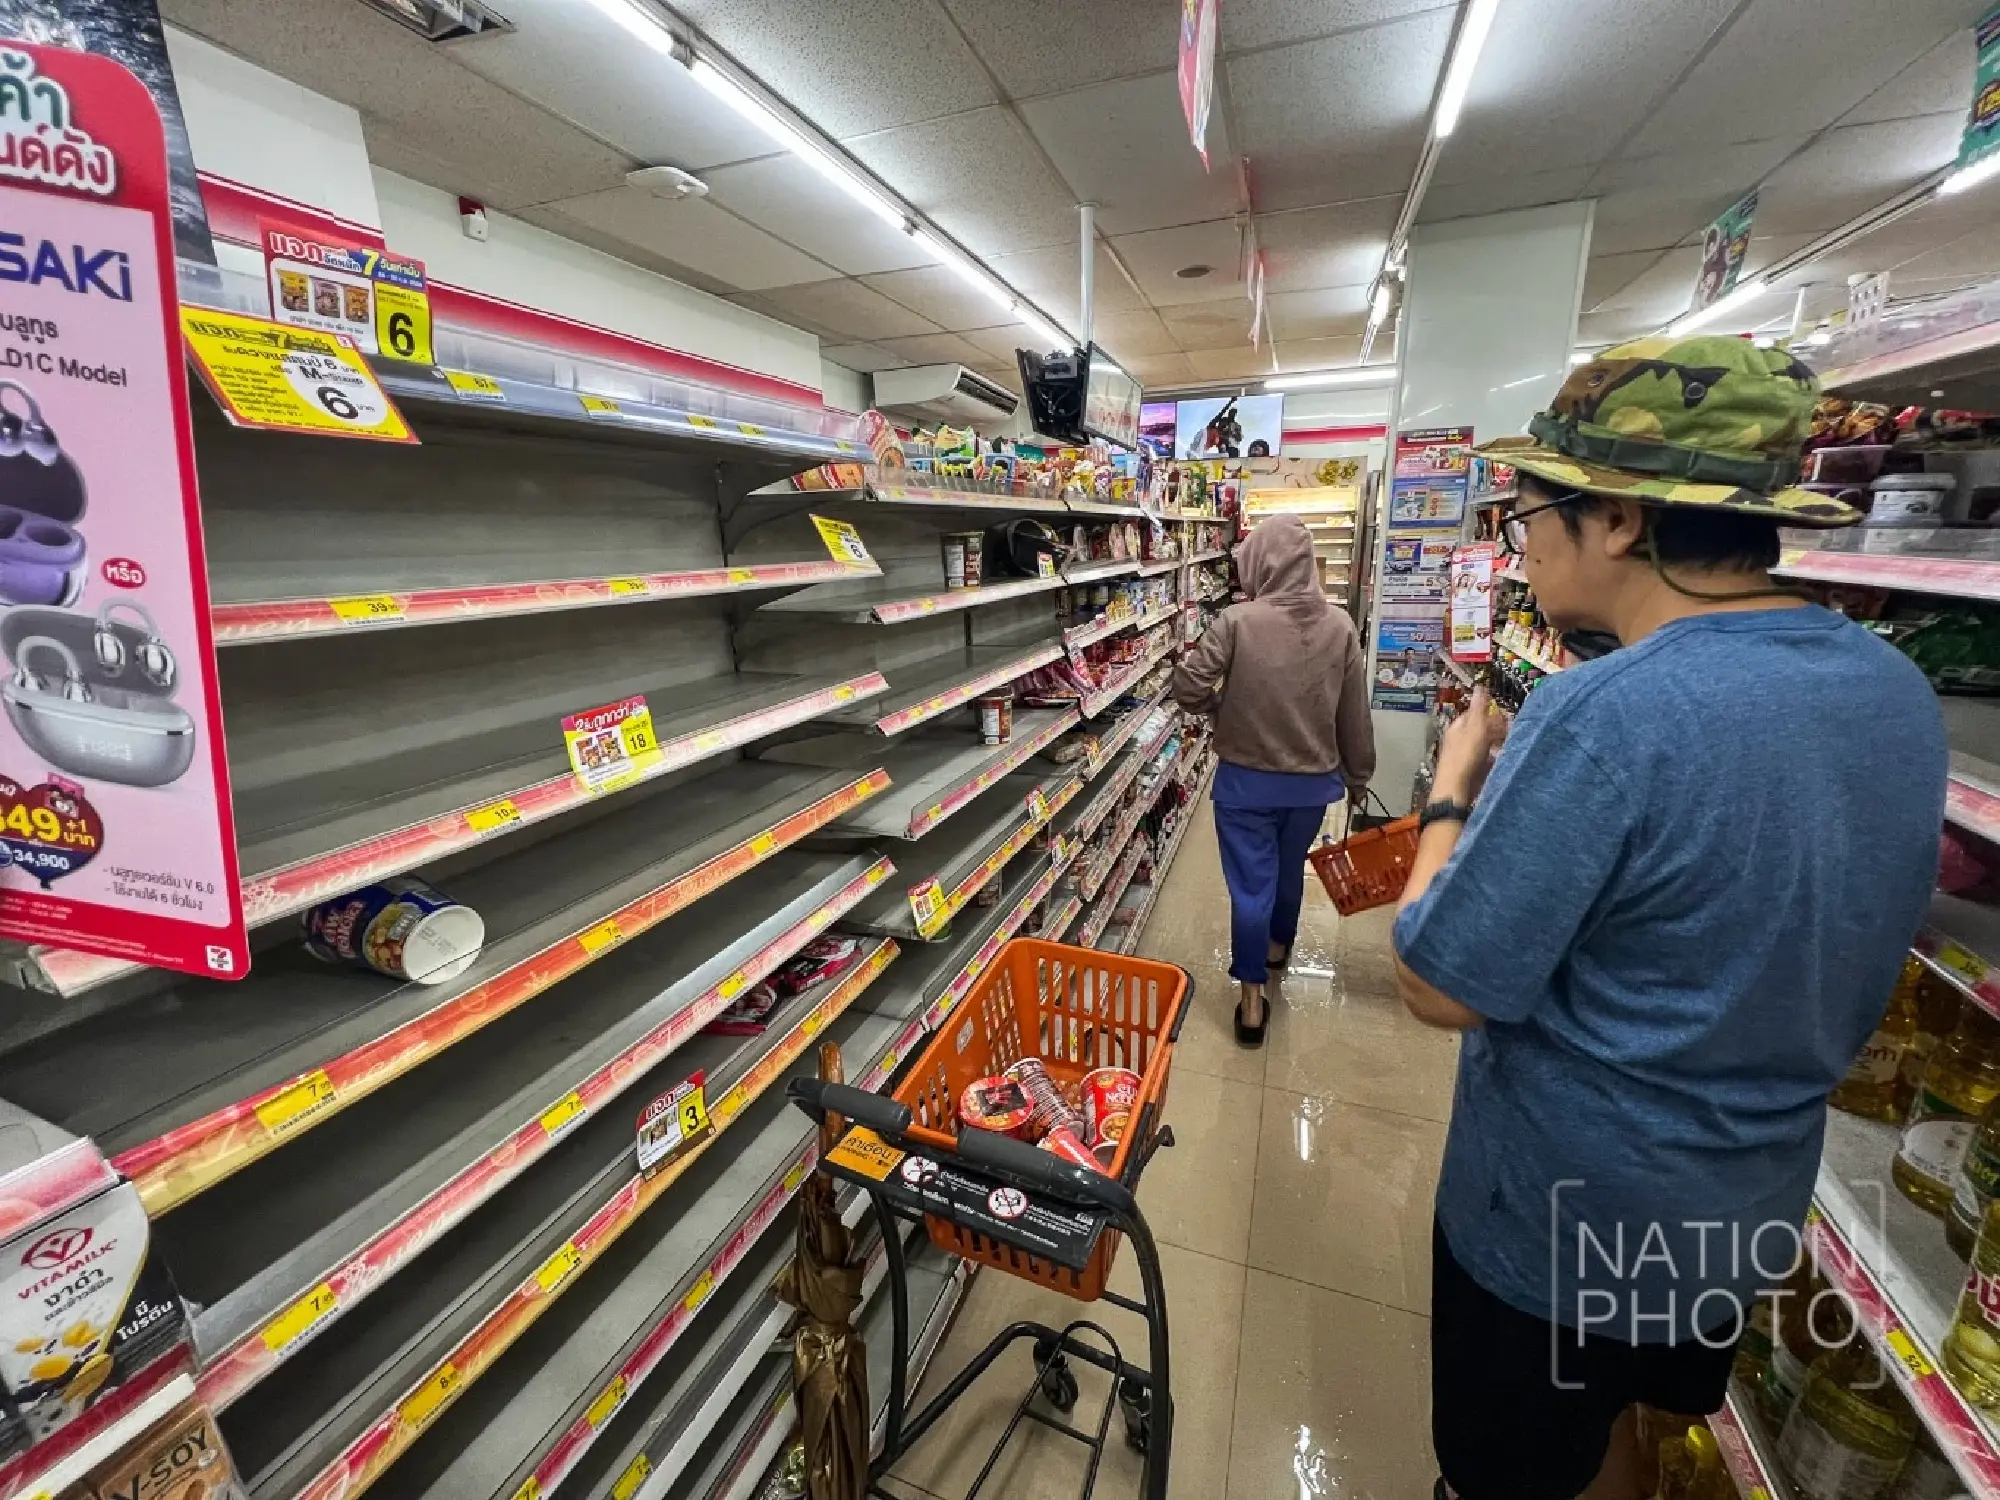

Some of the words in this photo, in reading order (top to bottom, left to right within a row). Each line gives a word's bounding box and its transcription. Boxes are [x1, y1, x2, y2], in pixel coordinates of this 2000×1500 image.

[361, 248, 379, 276] 7
[389, 312, 415, 357] 6
[59, 357, 127, 387] Model
[317, 386, 359, 420] 6
[629, 733, 647, 750] 18
[307, 1084, 317, 1097] 7
[685, 1106, 700, 1131] 3
[18, 1239, 117, 1299] VITAMILK
[44, 1268, 104, 1308] งาดำ
[310, 1297, 320, 1311] 7
[440, 1377, 449, 1389] 8
